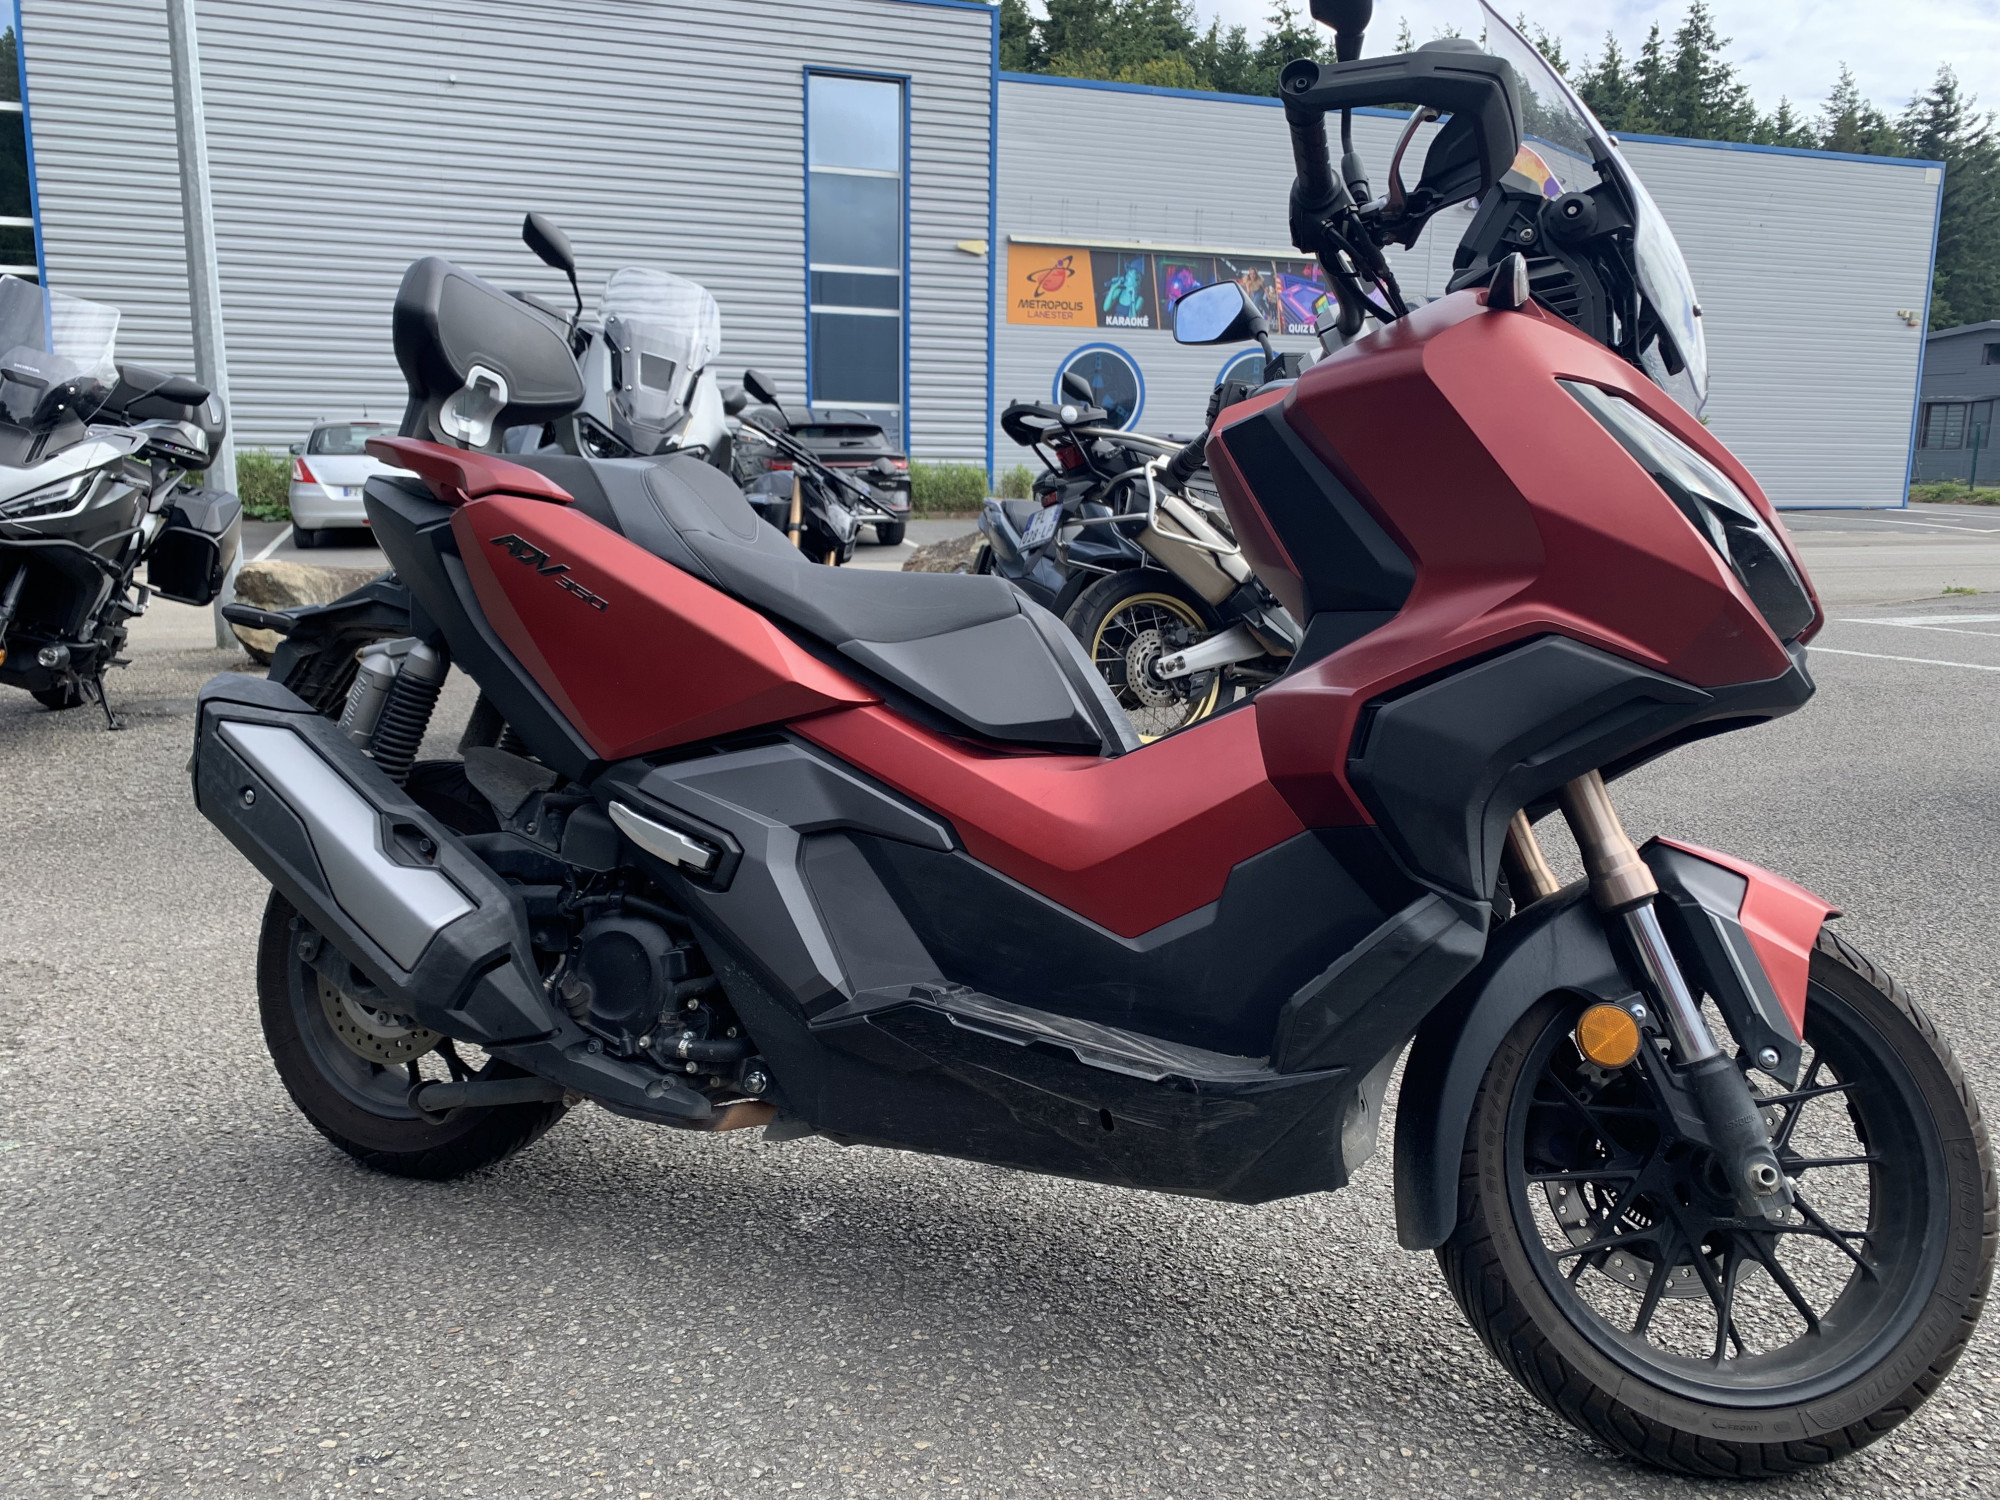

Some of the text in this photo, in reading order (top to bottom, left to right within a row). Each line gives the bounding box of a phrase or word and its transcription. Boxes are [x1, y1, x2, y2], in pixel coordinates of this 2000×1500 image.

[1018, 299, 1083, 311] METROPOLIS
[1027, 310, 1073, 320] LANESTER
[1288, 323, 1308, 334] QUIZ
[489, 533, 609, 611] ADV 350
[1957, 1170, 1977, 1231] GRIP
[1948, 1236, 1974, 1298] CITY
[1854, 1311, 1949, 1408] MICHELIN
[1728, 1424, 1759, 1432] FRONT
